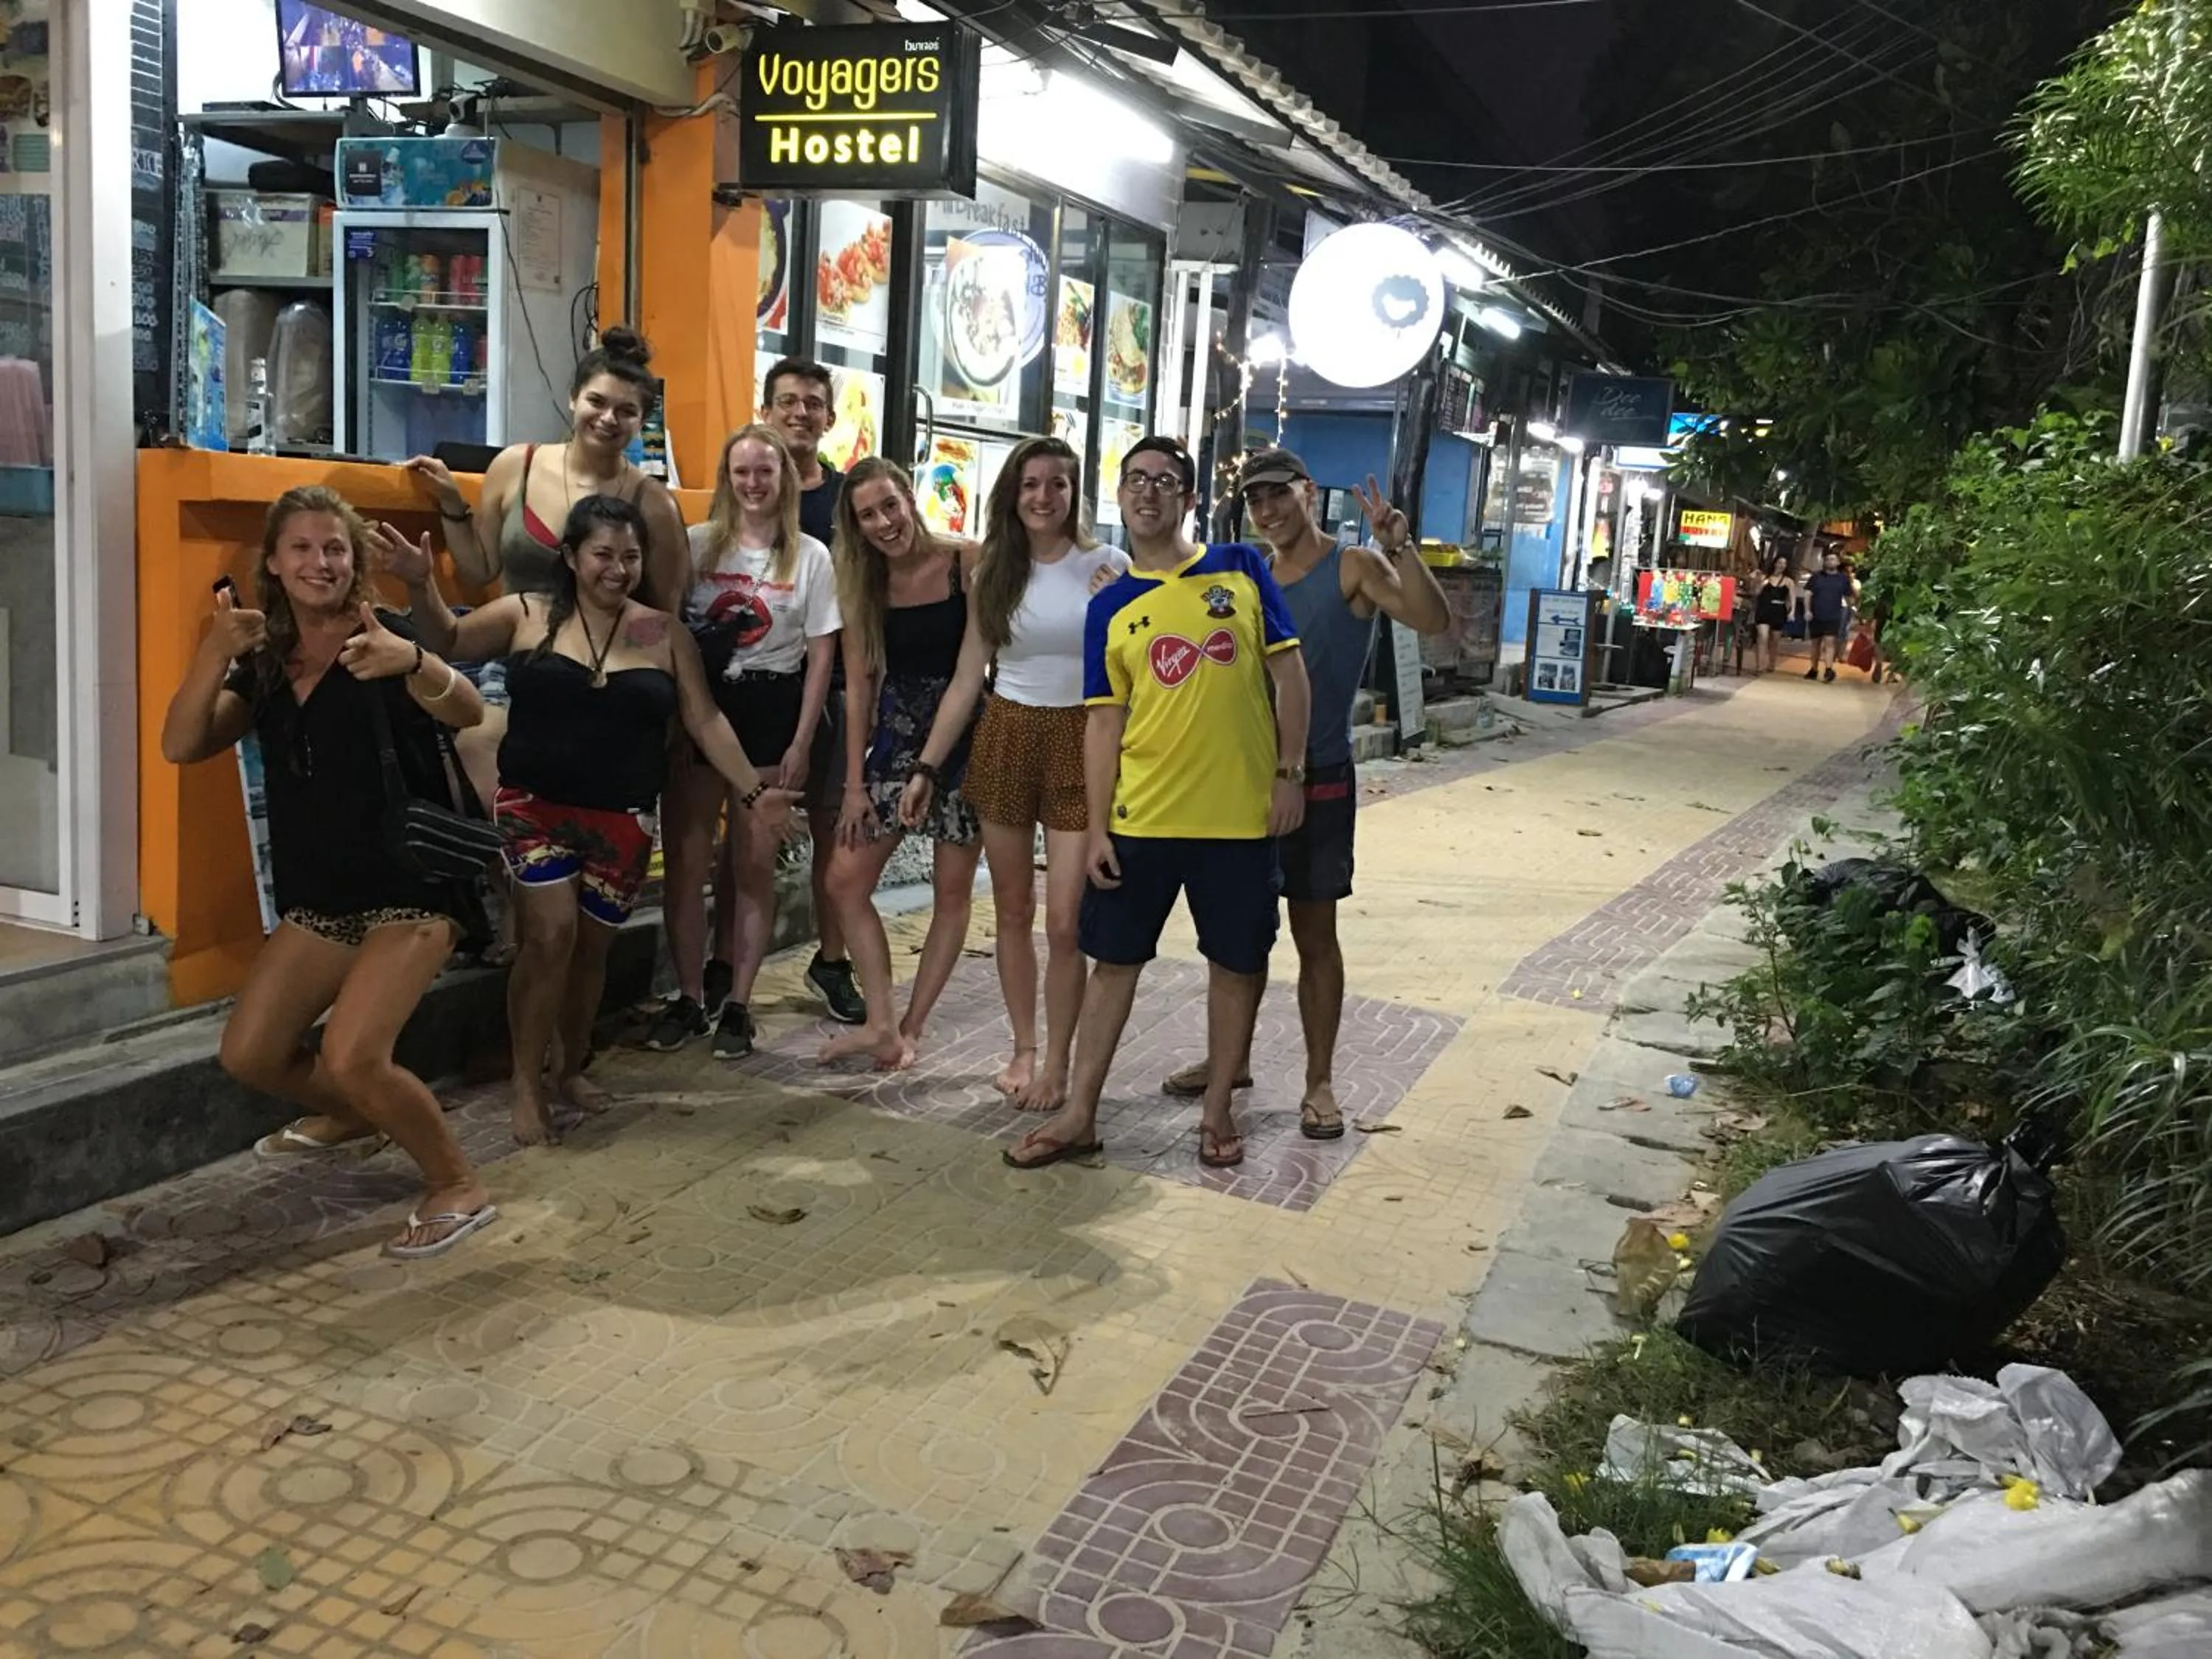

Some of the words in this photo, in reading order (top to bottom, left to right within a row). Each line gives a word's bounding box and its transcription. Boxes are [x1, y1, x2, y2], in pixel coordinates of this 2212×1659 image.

[759, 52, 940, 111] Voyagers
[771, 125, 919, 163] Hostel
[1156, 644, 1190, 678] Virgin
